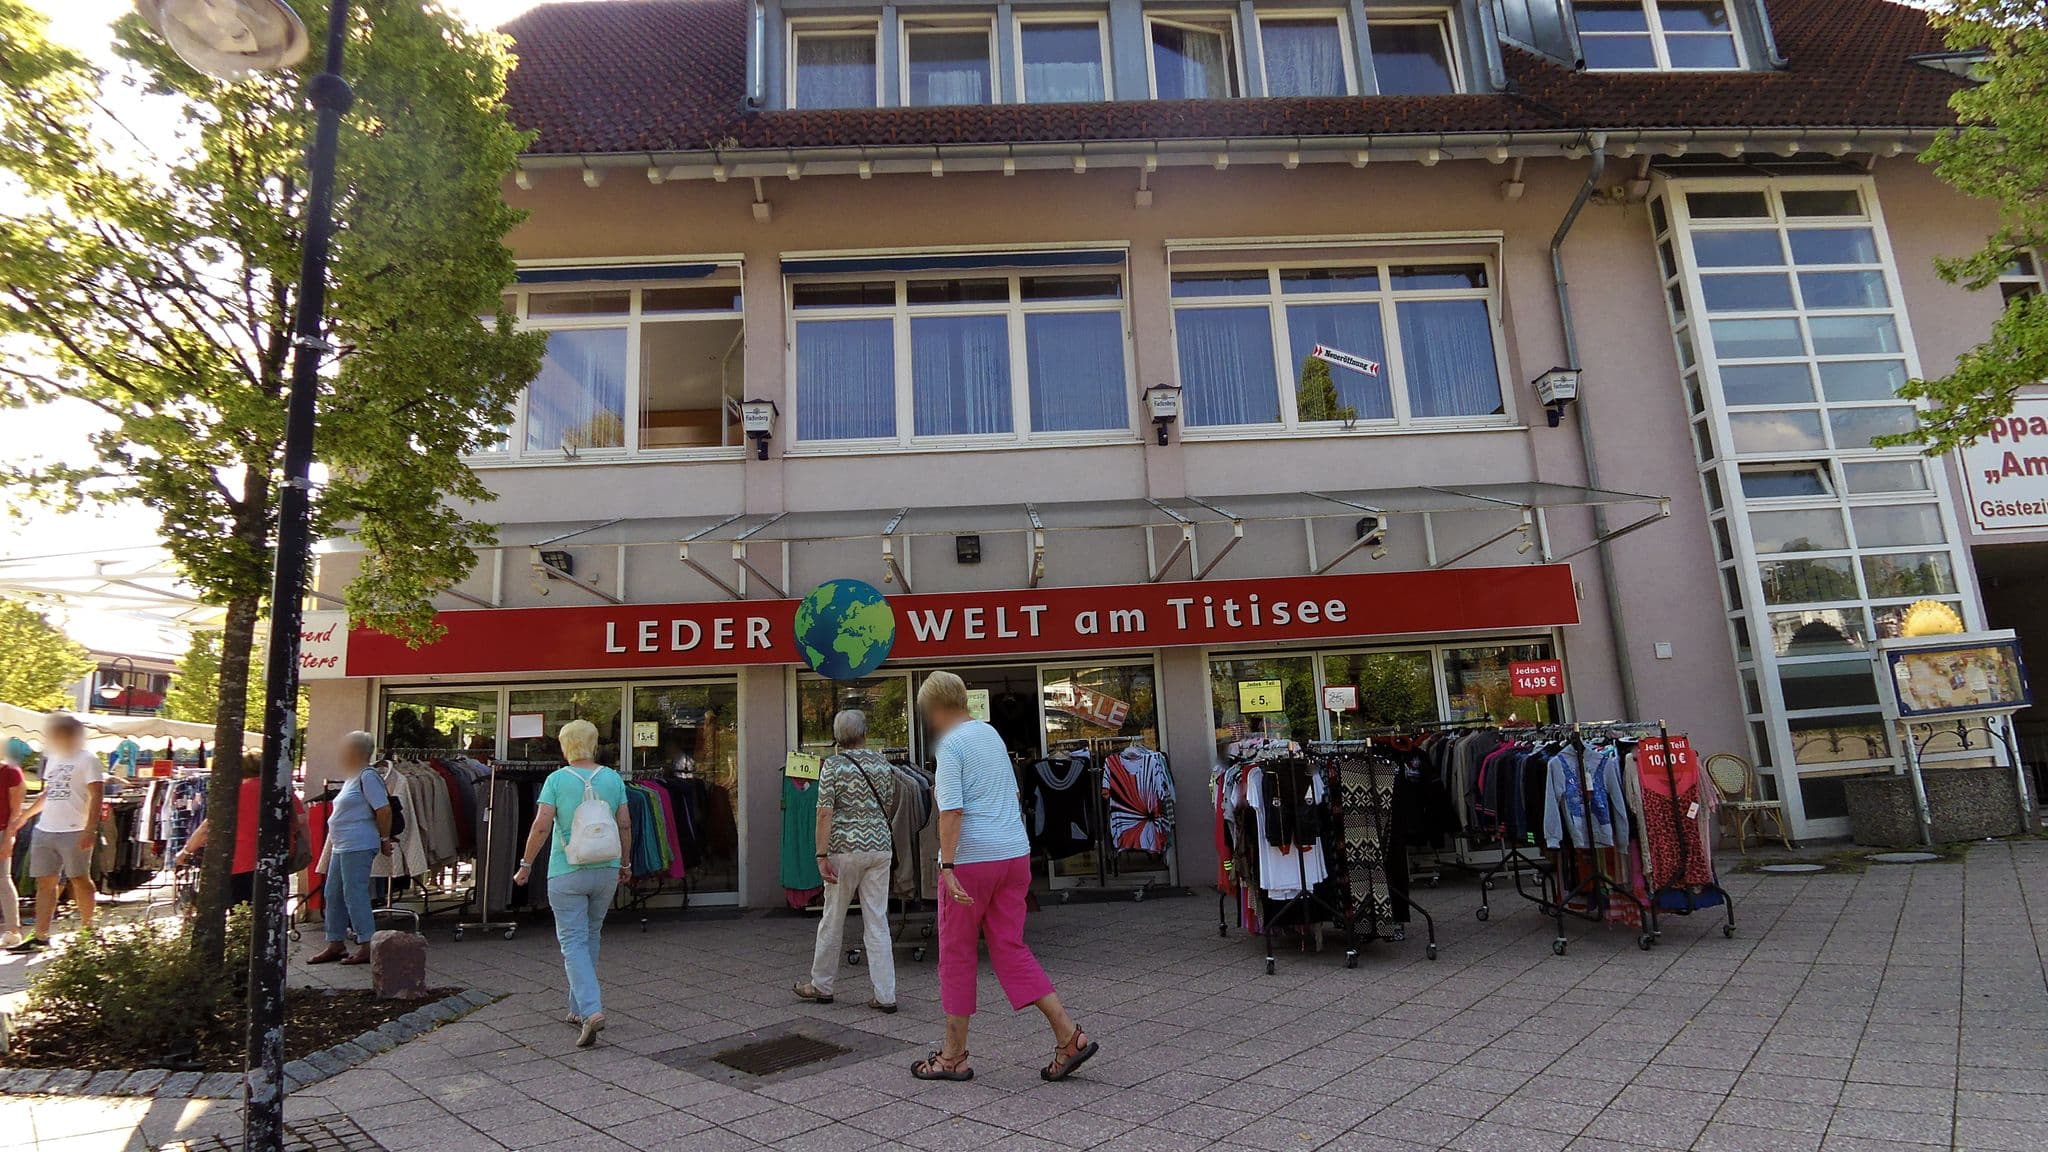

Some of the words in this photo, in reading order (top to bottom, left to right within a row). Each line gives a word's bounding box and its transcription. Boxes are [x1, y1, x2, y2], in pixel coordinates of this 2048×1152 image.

[1324, 349, 1369, 371] Neueröffnung
[1981, 415, 2048, 443] ppa
[1984, 450, 2048, 484] „Am
[1980, 498, 2048, 517] Gästezi
[906, 604, 1048, 642] WELT
[1073, 608, 1147, 635] am
[1166, 593, 1348, 631] Titisee
[300, 621, 337, 643] rend
[606, 616, 773, 653] LEDER
[1515, 667, 1540, 675] Jedes
[1541, 665, 1557, 673] Teil
[1518, 676, 1547, 689] 14,99
[1550, 676, 1557, 687] €
[1645, 742, 1666, 751] Jede
[1669, 740, 1685, 749] Teil
[1679, 752, 1686, 764] €
